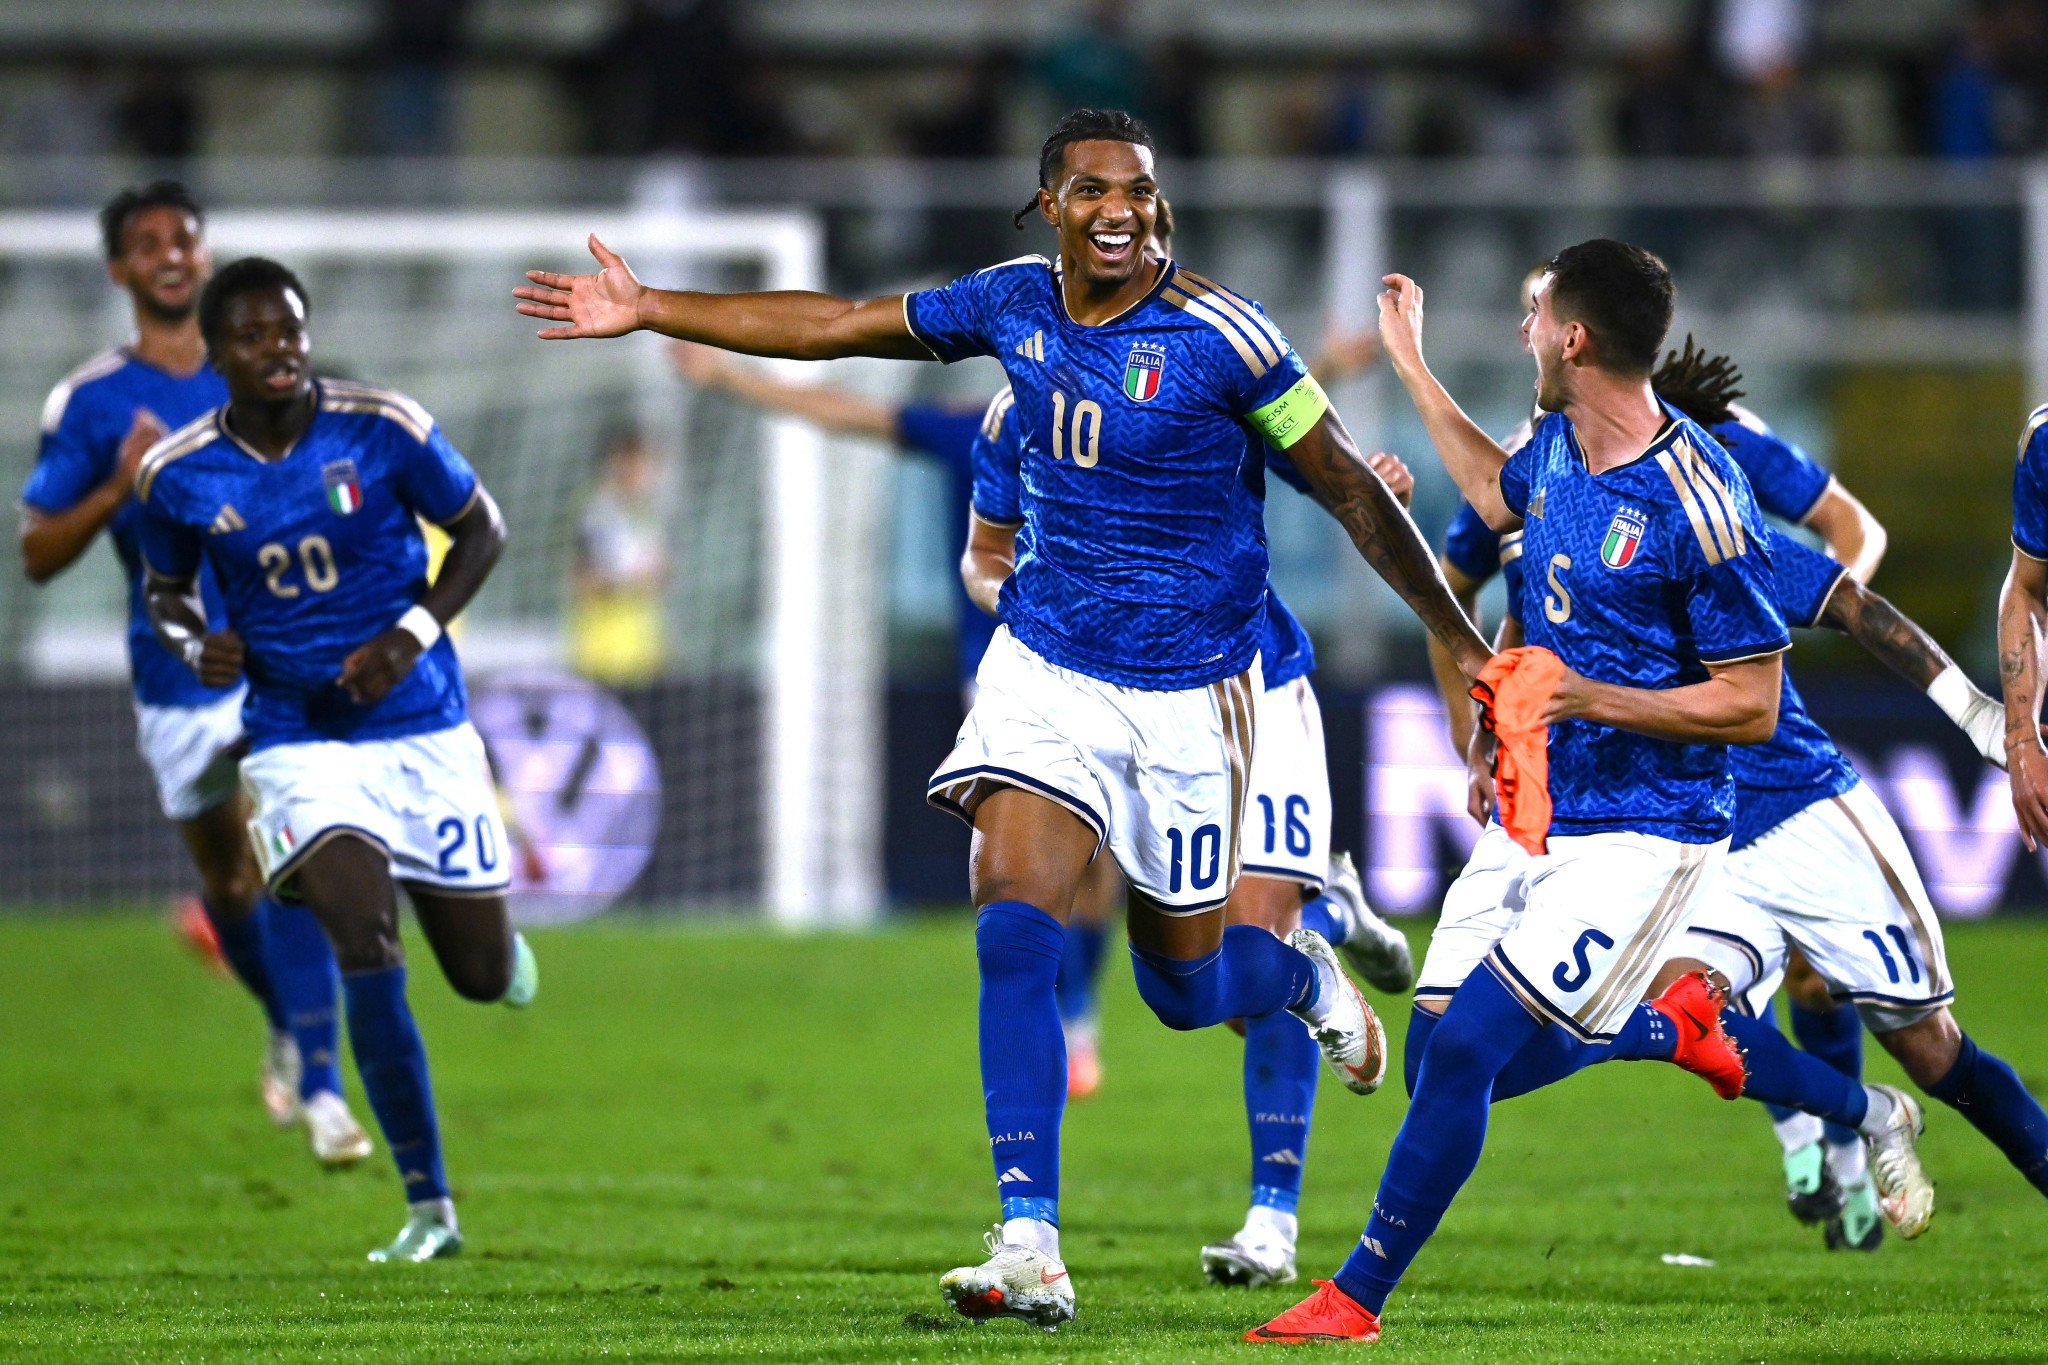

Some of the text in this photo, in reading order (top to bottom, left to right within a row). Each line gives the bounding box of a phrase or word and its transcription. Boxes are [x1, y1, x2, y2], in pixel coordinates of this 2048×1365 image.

[1130, 354, 1161, 367] ITALIA
[1052, 391, 1102, 468] 10
[1613, 519, 1641, 537] ITALIA
[258, 534, 339, 598] 20
[437, 814, 498, 878] 20
[1257, 794, 1311, 858] 16
[1166, 824, 1221, 894] 10
[1862, 924, 1920, 984] 11
[1255, 1112, 1306, 1125] ITALIA
